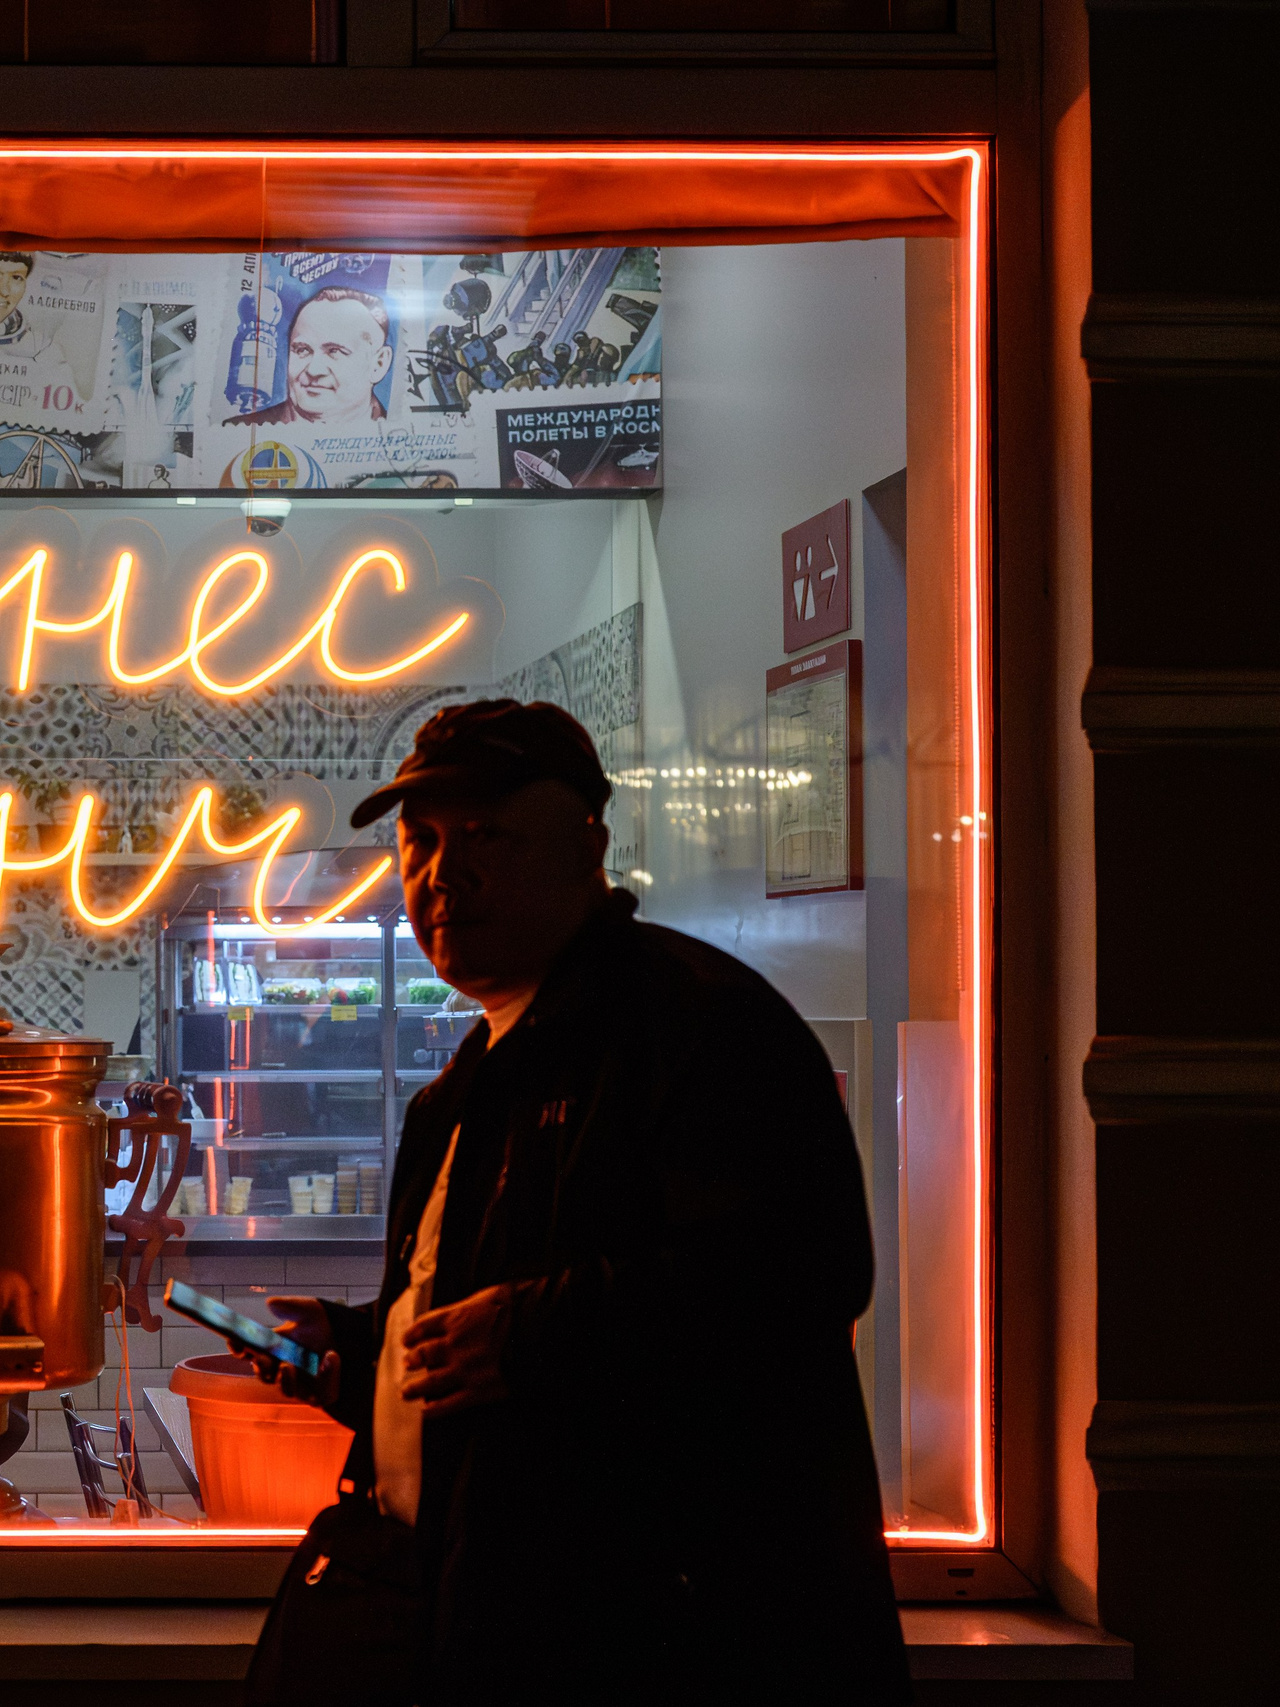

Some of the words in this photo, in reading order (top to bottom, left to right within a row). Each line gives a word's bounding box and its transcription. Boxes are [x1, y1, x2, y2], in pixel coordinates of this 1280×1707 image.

[241, 279, 253, 291] 12
[508, 426, 588, 444] ПОЛЕТЫ
[595, 426, 607, 439] В
